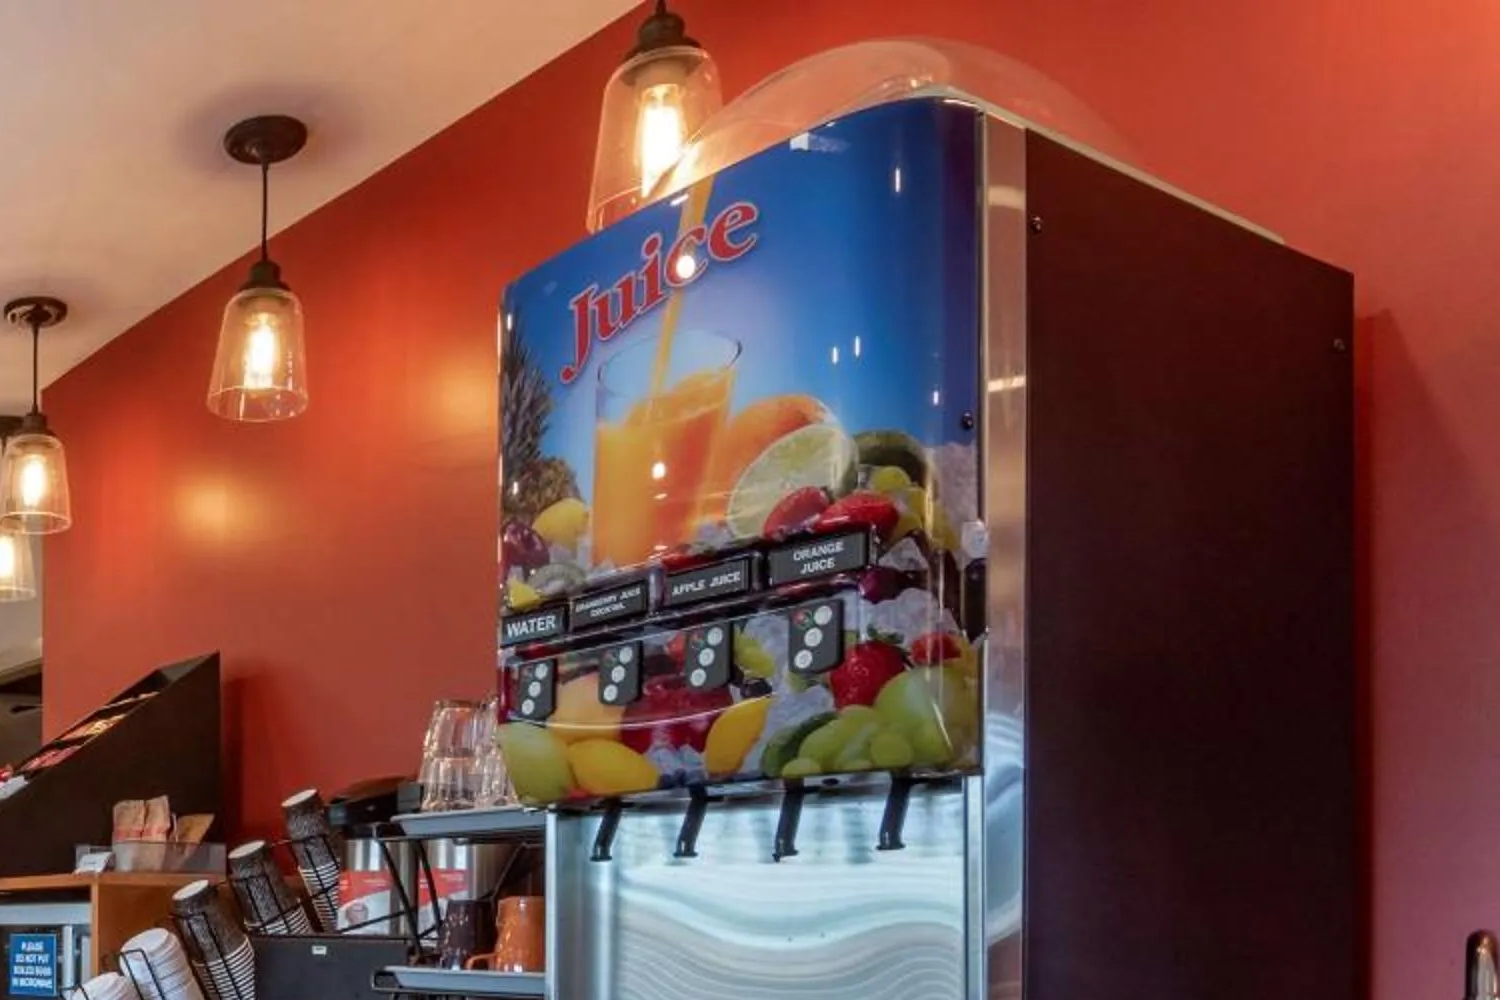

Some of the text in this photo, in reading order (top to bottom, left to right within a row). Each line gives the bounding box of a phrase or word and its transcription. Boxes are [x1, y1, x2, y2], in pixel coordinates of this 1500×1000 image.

[559, 201, 759, 384] Juice
[793, 541, 844, 561] ORANGE
[800, 557, 836, 574] JUICE
[671, 571, 742, 597] APPLE JUICE
[507, 613, 557, 638] WATER
